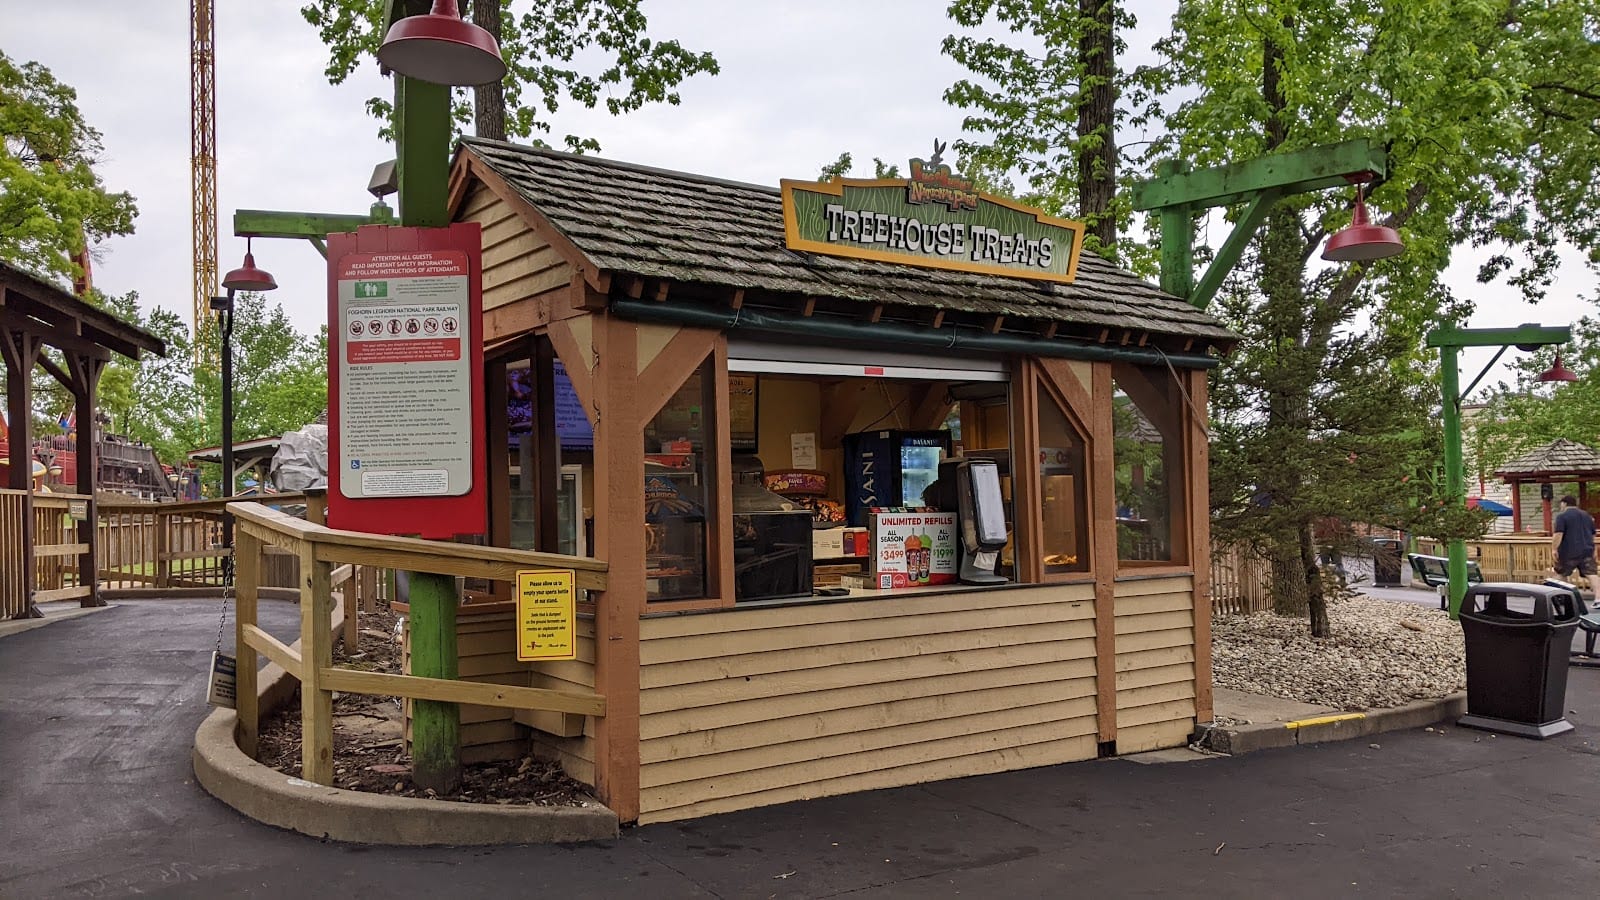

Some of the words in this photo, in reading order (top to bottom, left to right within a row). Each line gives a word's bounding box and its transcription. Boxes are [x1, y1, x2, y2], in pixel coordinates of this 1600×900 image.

[826, 204, 965, 255] TREEHOUSE
[969, 225, 1053, 268] TREATS
[860, 452, 878, 504] SANI
[882, 517, 922, 526] UNLIMITED
[924, 517, 952, 525] REFILLS
